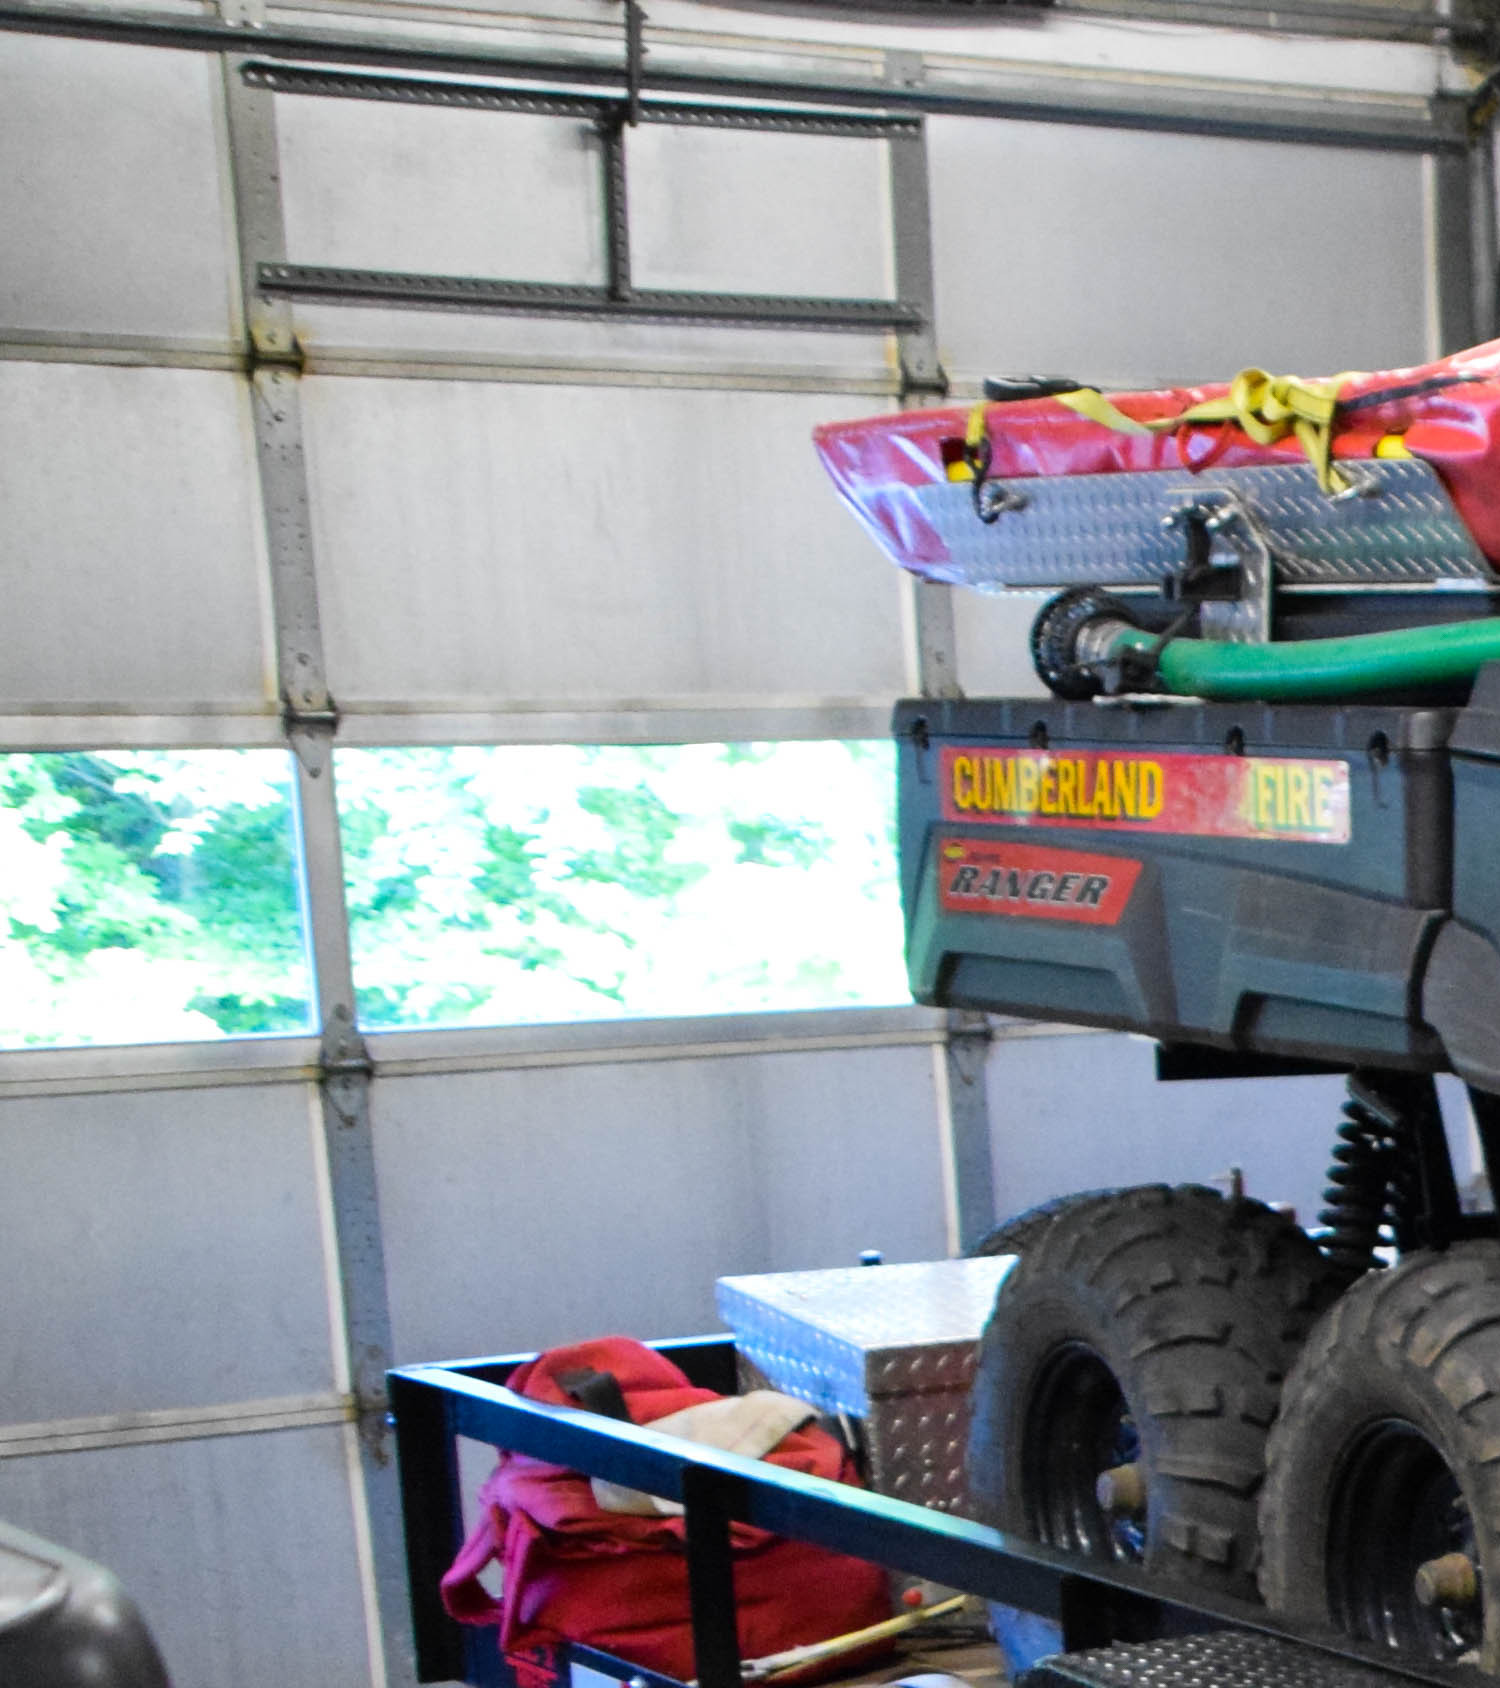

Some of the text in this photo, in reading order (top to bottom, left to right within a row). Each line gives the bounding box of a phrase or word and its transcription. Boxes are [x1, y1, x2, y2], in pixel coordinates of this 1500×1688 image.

[953, 756, 1336, 829] CUMBERLAND FIRE
[949, 863, 1111, 909] RANGER
